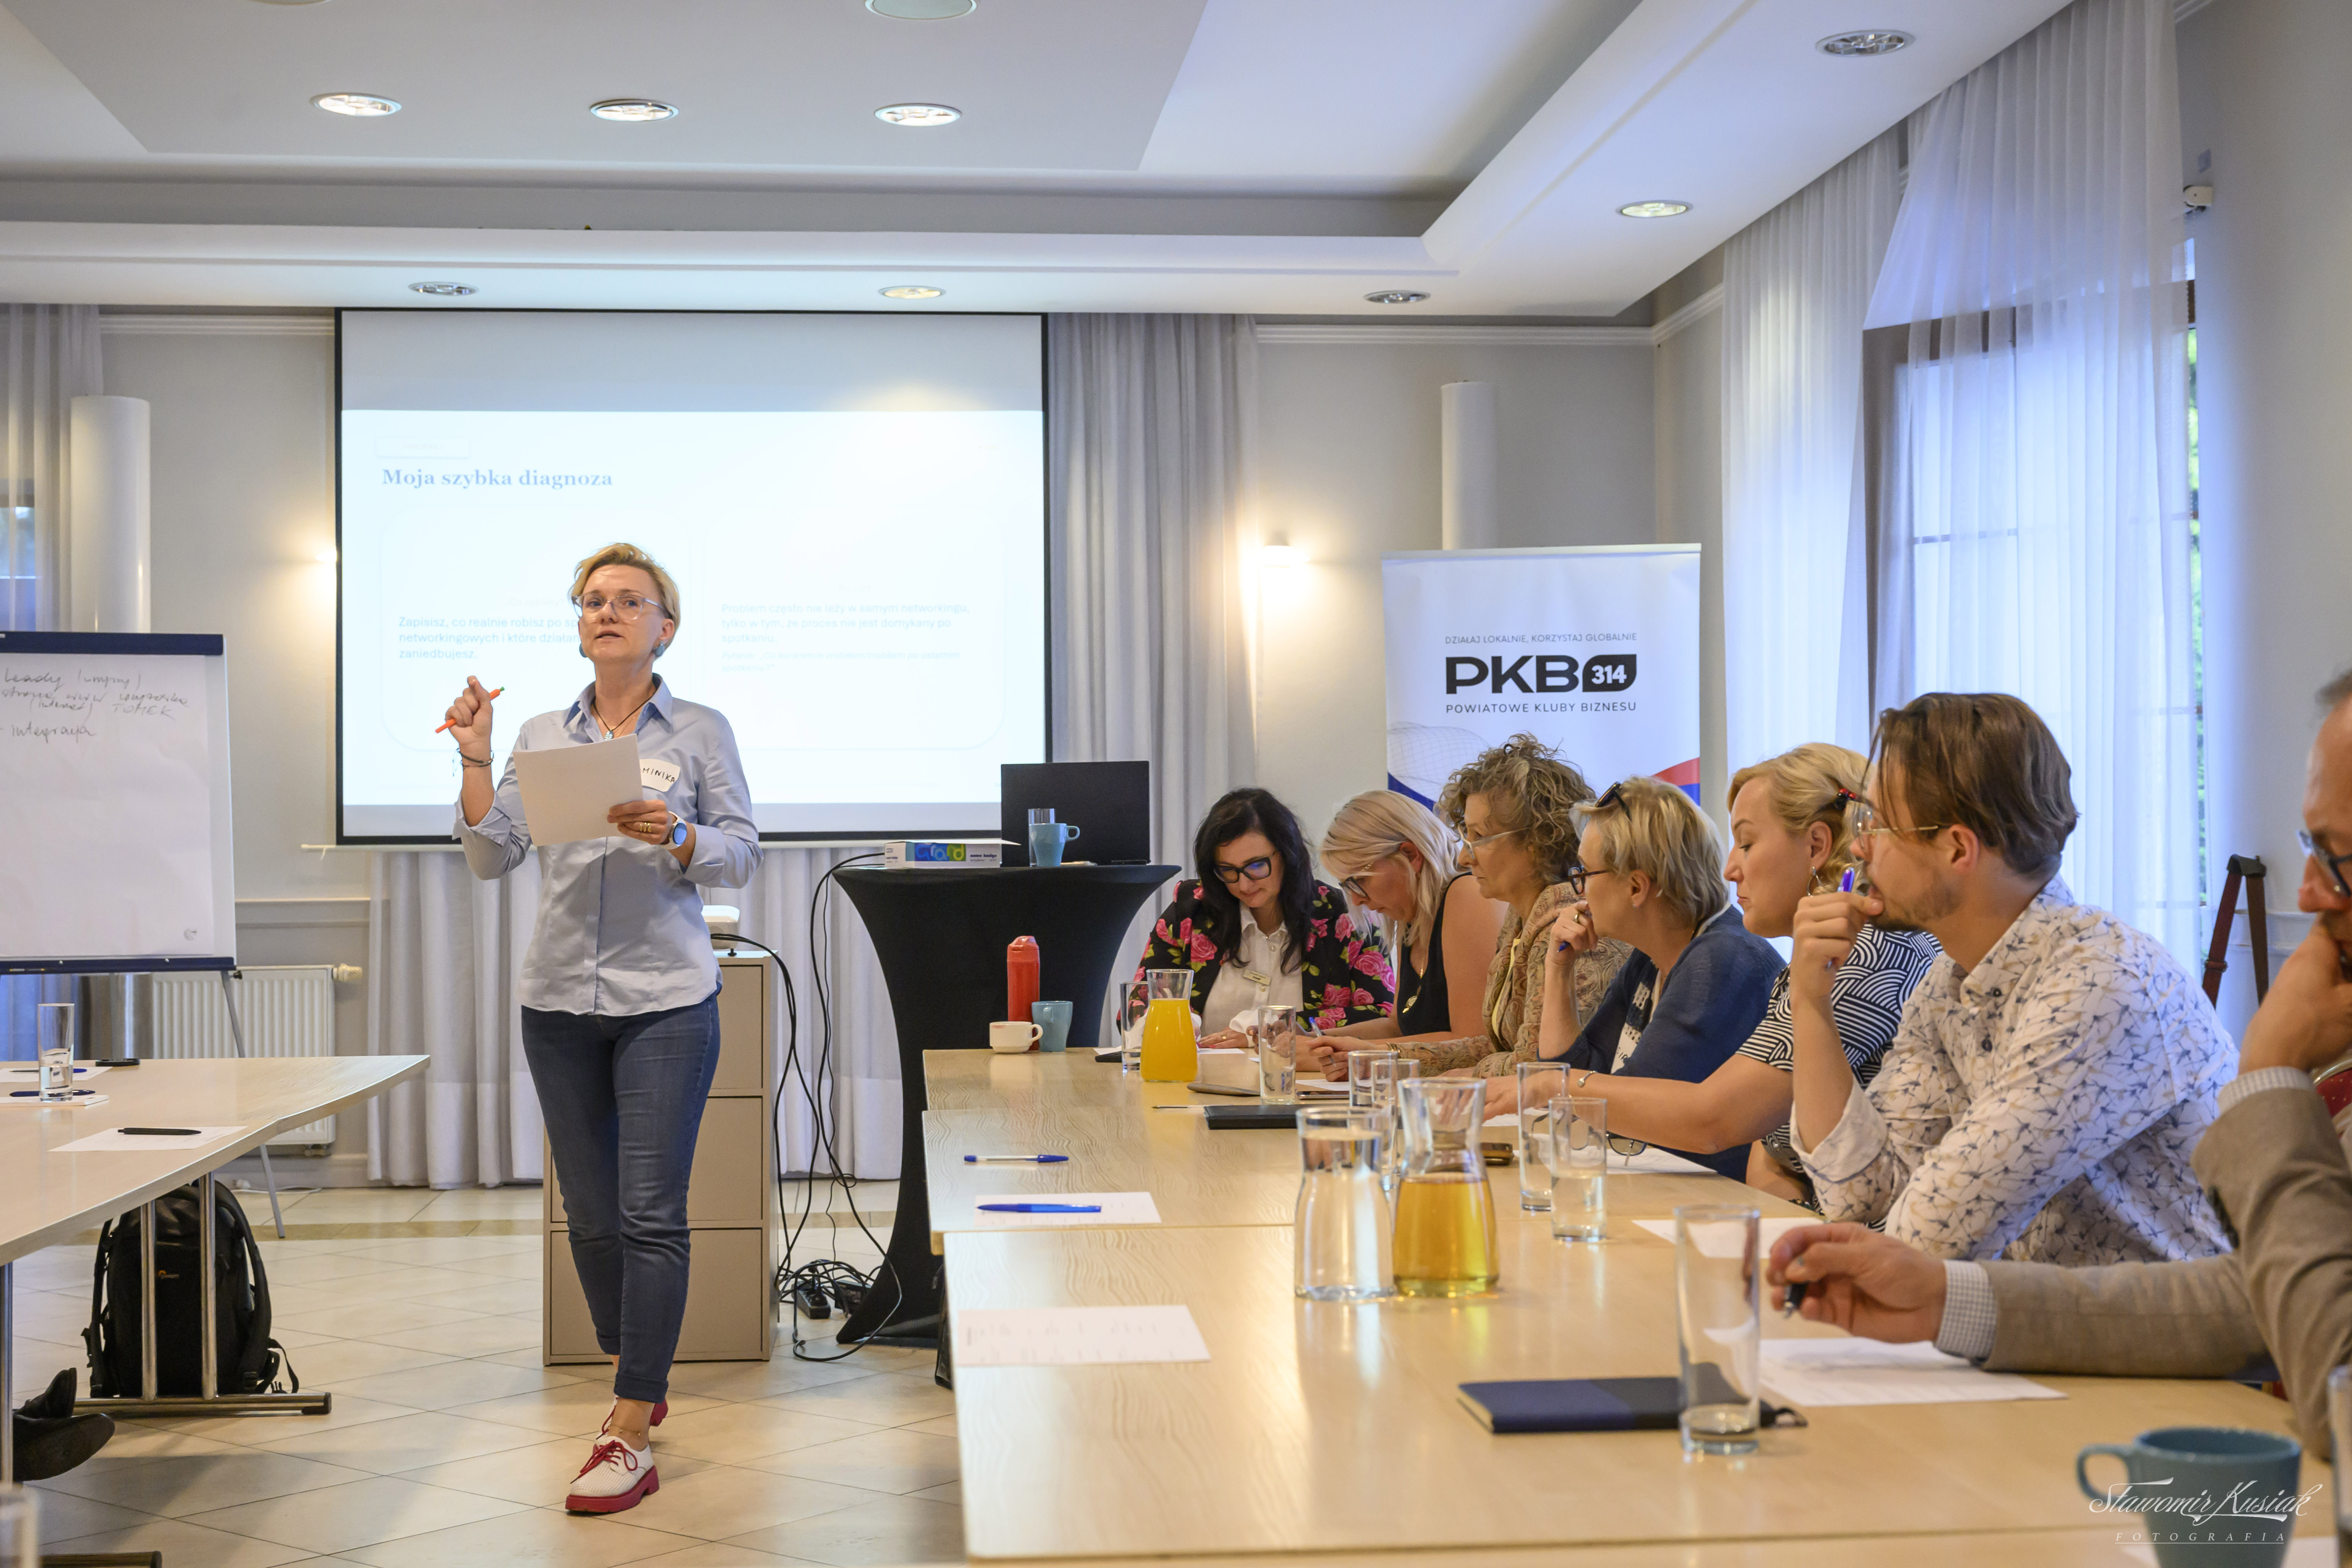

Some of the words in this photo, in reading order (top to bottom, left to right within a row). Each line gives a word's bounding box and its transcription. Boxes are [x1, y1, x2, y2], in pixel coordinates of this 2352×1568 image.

[383, 469, 435, 488] Moja
[441, 469, 512, 489] szybka
[518, 469, 612, 490] diagnoza
[721, 604, 766, 613] Problem
[769, 604, 803, 615] często
[806, 604, 822, 613] nie
[825, 604, 845, 615] leży
[859, 605, 898, 615] samym
[901, 604, 970, 615] networkingu,
[399, 617, 448, 629] Zapisisz,
[469, 617, 508, 627] realnie
[511, 617, 544, 627] robisz
[547, 620, 561, 629] po
[721, 619, 746, 630] tylko
[761, 619, 784, 630] tym,
[787, 619, 798, 628] że
[801, 620, 838, 629] proces
[840, 619, 856, 627] nie
[858, 619, 878, 630] jest
[880, 618, 935, 630] domykany
[937, 620, 951, 629] po
[399, 633, 499, 645] networkingowych
[502, 633, 505, 642] i
[508, 633, 536, 643] które
[539, 633, 579, 643] działan
[721, 634, 777, 644] spotkaniu.
[1445, 635, 1480, 644] DZIAŁAJ
[1483, 635, 1529, 643] LOKALNIE,
[1531, 634, 1582, 642] KORZYSTAJ
[1585, 633, 1636, 642] GLOBALNIE
[399, 649, 477, 660] zaniedbujesz.
[778, 651, 824, 660] konkretnie
[921, 651, 961, 660] ostatnim
[1446, 655, 1579, 695] PKB
[1591, 664, 1627, 684] 314
[1446, 703, 1529, 714] POWIATOWE
[1535, 703, 1575, 712] KLUBY
[1581, 702, 1636, 712] BIZNESU
[642, 767, 676, 782] MINIKA
